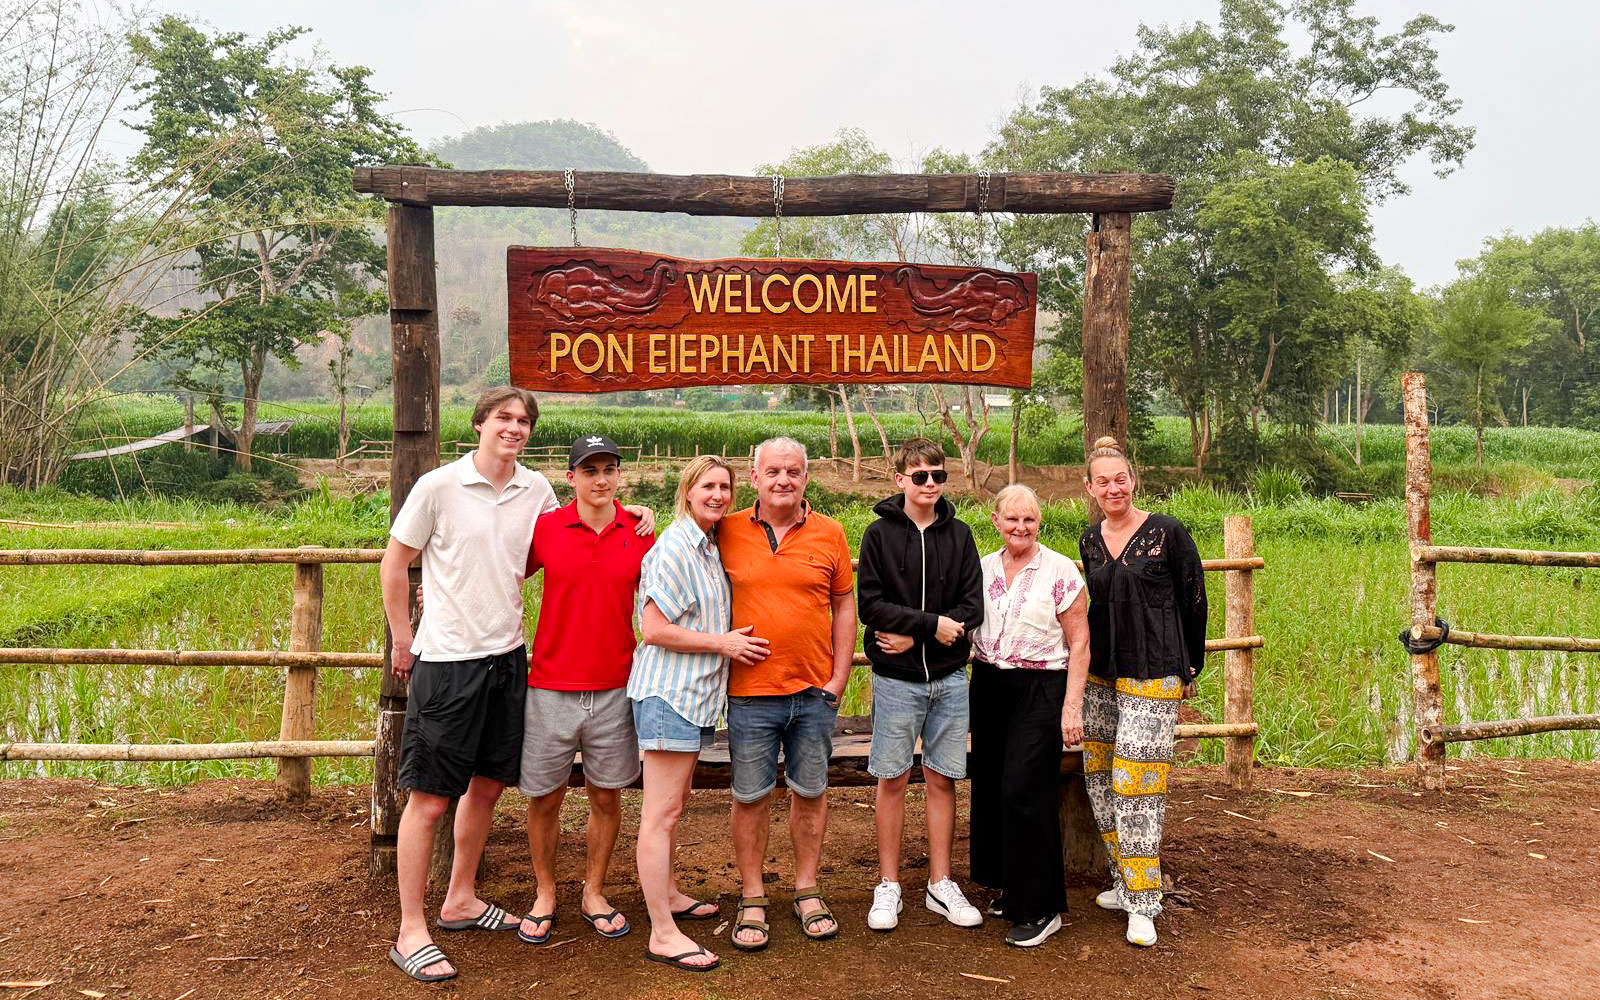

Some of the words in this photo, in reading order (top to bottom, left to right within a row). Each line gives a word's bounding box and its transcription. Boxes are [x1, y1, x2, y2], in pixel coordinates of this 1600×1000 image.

[686, 273, 877, 314] WELCOME
[550, 332, 634, 374] PON
[825, 333, 996, 374] THAILAND
